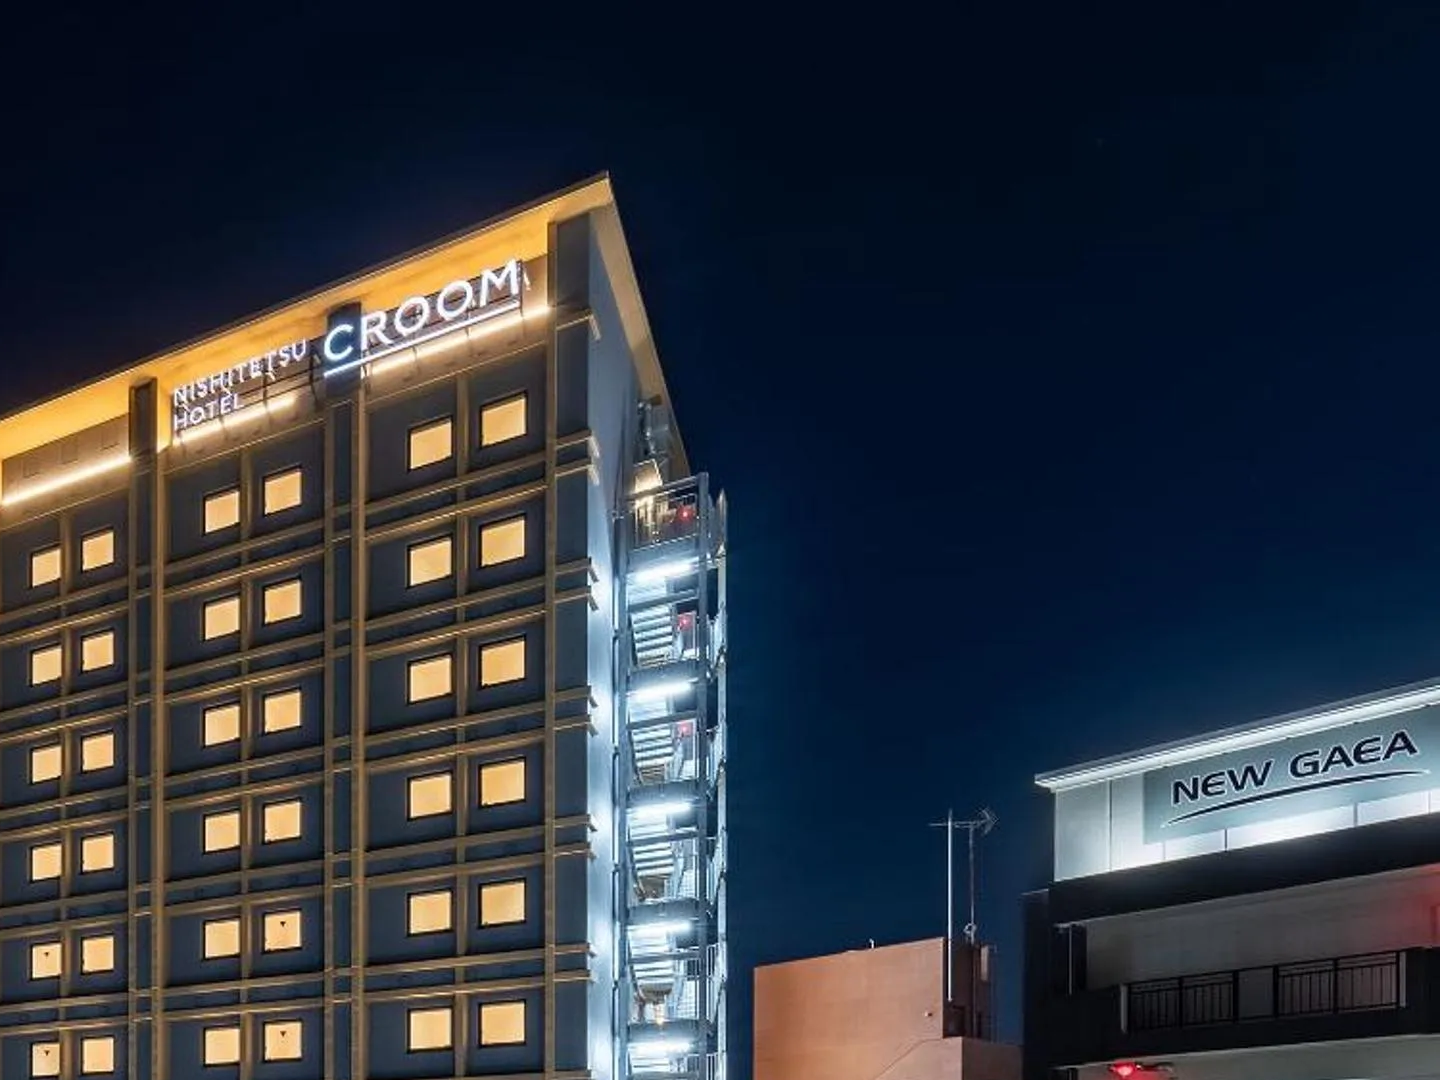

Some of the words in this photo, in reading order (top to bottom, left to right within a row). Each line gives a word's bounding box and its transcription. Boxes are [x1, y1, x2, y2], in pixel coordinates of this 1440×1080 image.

[323, 258, 520, 362] CROOM
[173, 339, 307, 406] NISHITETSU
[173, 393, 244, 431] HOTEL
[1171, 759, 1274, 805] NEW
[1289, 729, 1418, 778] GAEA
